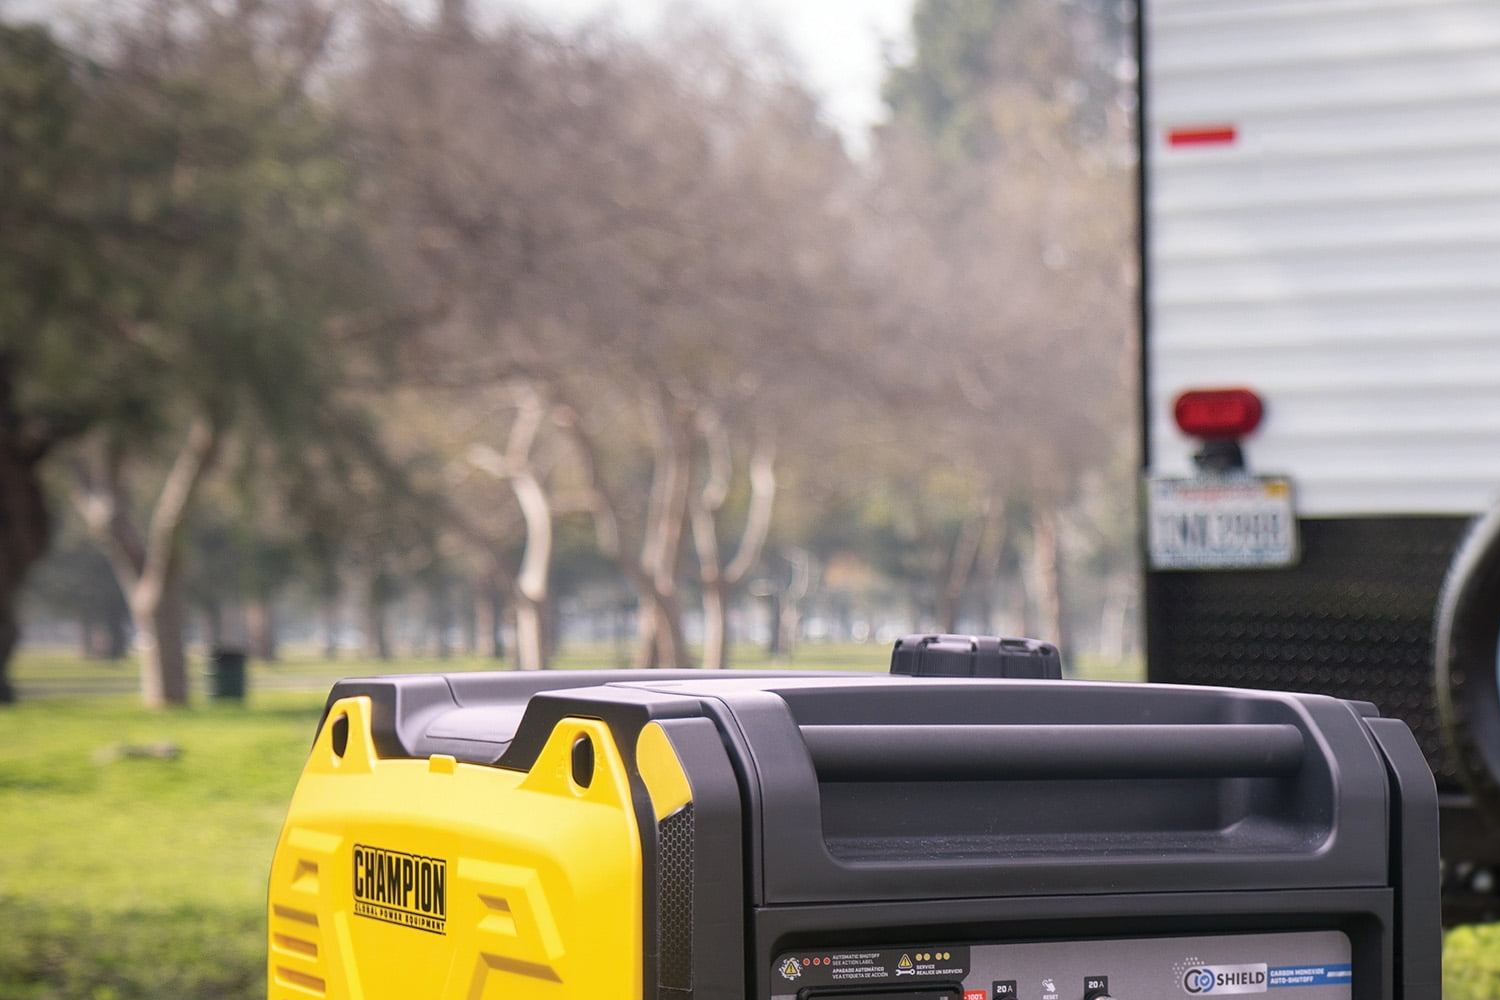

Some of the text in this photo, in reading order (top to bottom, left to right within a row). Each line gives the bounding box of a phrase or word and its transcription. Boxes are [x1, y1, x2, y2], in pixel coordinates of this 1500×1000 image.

[354, 849, 445, 916] CHAMPION
[354, 902, 445, 931] GLOBAL POWER EQUIPMENT
[1216, 971, 1264, 987] SHIELD
